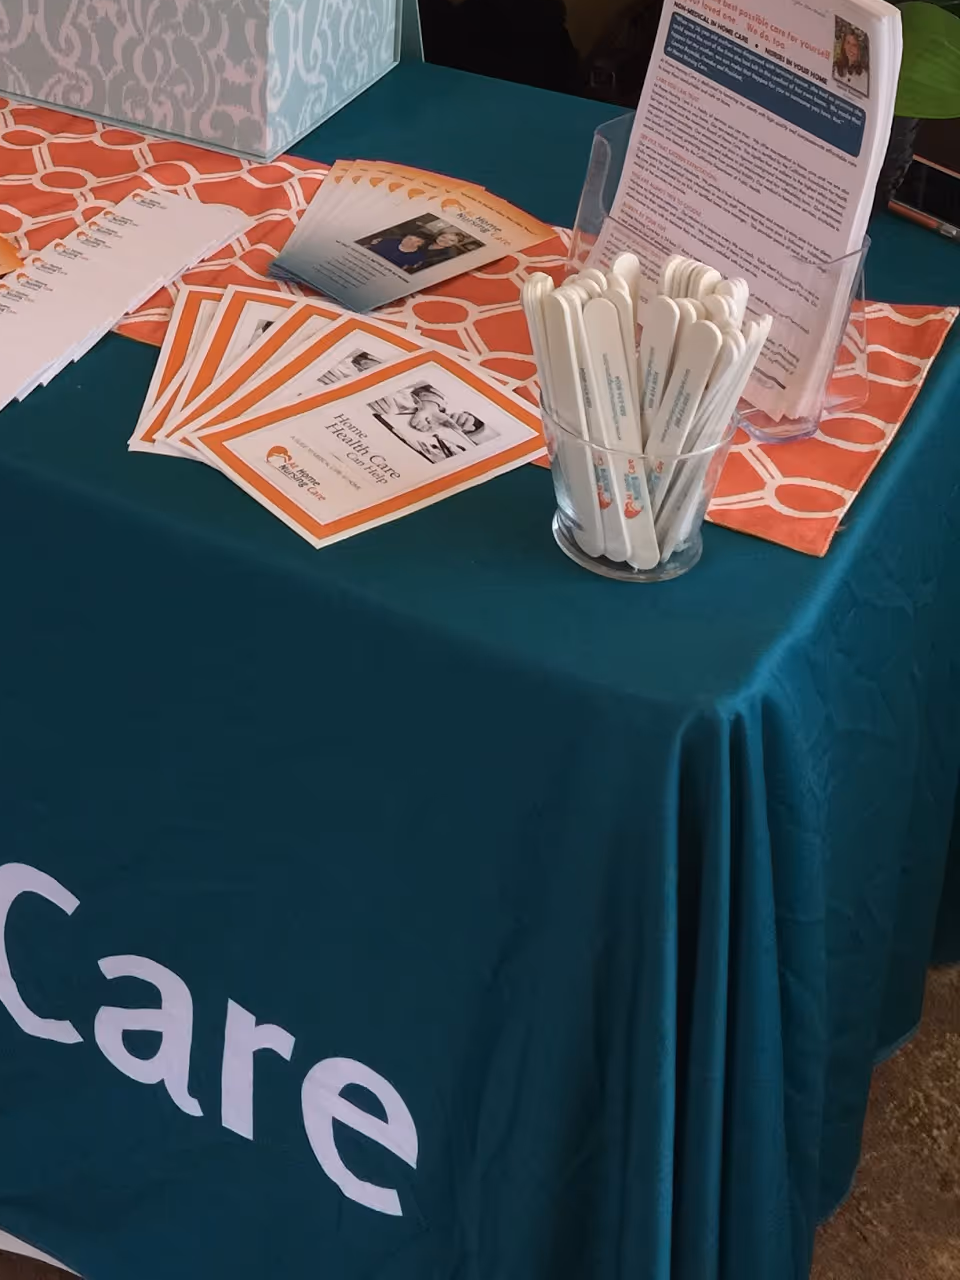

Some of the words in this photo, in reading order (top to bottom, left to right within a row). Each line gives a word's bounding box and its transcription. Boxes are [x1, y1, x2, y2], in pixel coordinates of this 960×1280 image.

[738, 5, 769, 29] possible
[769, 23, 785, 36] care
[786, 31, 798, 43] for
[798, 37, 830, 60] yourself
[457, 212, 490, 233] Nursing
[490, 233, 511, 246] Care
[475, 216, 502, 232] Home
[333, 413, 368, 439] Home
[324, 422, 369, 456] Health
[369, 454, 401, 480] Care
[278, 464, 308, 488] Nursing
[307, 486, 326, 501] Care
[296, 468, 320, 486] Home
[346, 452, 365, 467] Can
[364, 465, 388, 485] Help
